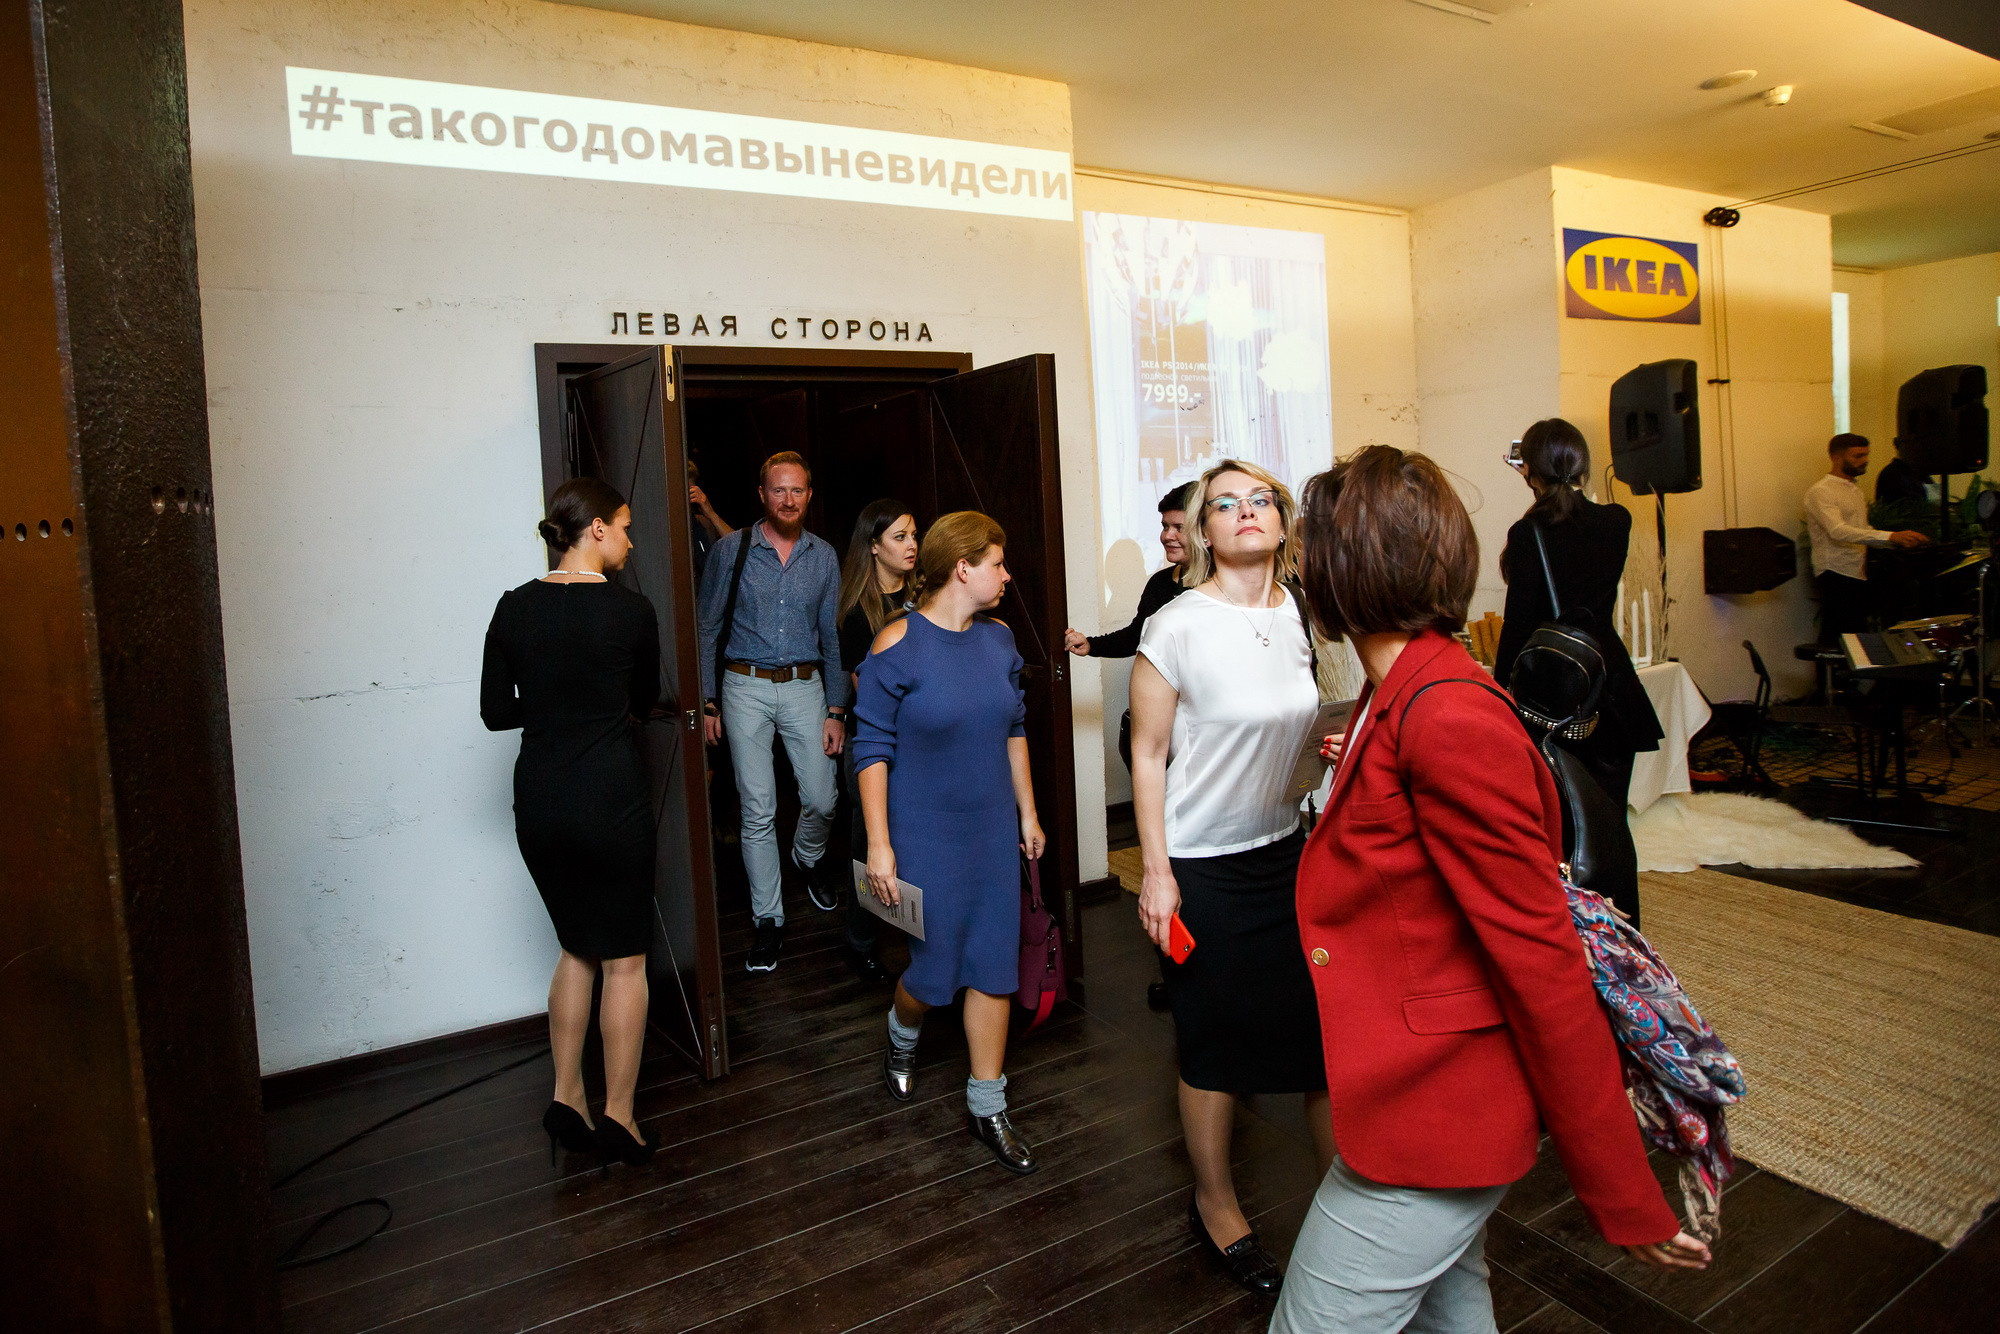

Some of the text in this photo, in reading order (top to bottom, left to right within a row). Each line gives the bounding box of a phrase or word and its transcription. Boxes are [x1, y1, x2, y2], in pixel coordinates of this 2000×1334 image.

[299, 85, 1067, 200] #такогодомавыневидели
[1584, 254, 1688, 297] IKEA
[611, 312, 933, 342] ЛЕВАЯ СТОРОНА
[1140, 361, 1160, 369] IKEA
